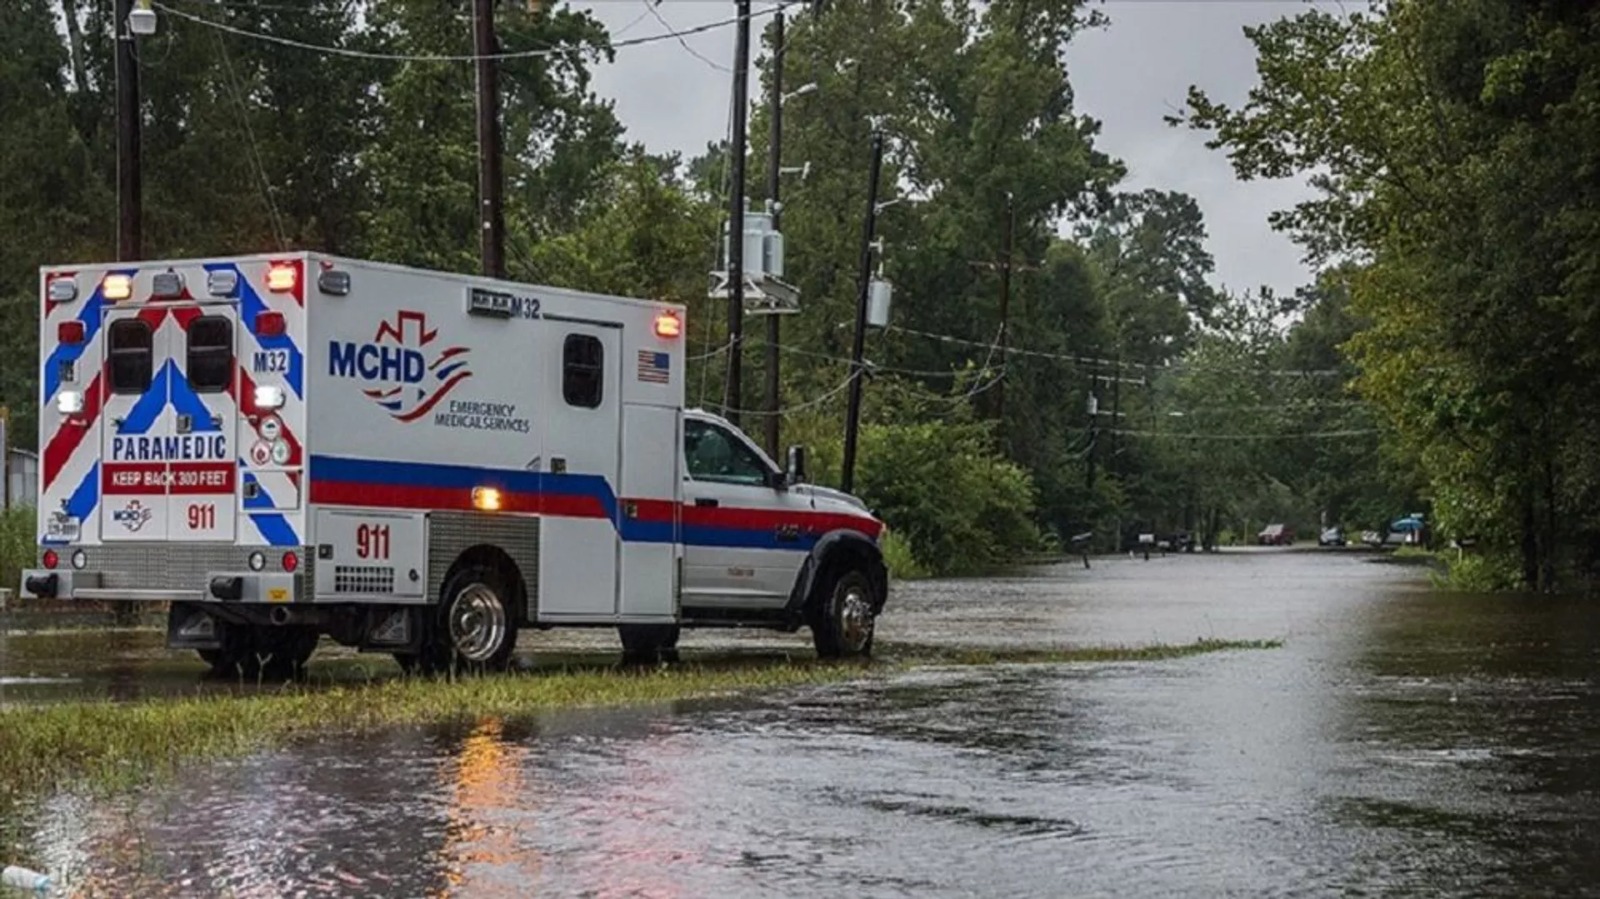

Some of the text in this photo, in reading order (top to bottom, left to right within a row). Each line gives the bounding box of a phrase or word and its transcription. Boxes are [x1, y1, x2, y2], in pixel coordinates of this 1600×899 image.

[510, 297, 540, 319] M32
[254, 351, 286, 372] M32
[328, 340, 425, 384] MCHD
[450, 400, 515, 417] EMERGENCY
[435, 413, 530, 434] MEDICAL SERVICES
[112, 435, 226, 460] PARAMEDIC
[112, 470, 228, 486] KEEP BACK 300 FEET
[188, 504, 215, 529] 911
[356, 523, 390, 560] 911
